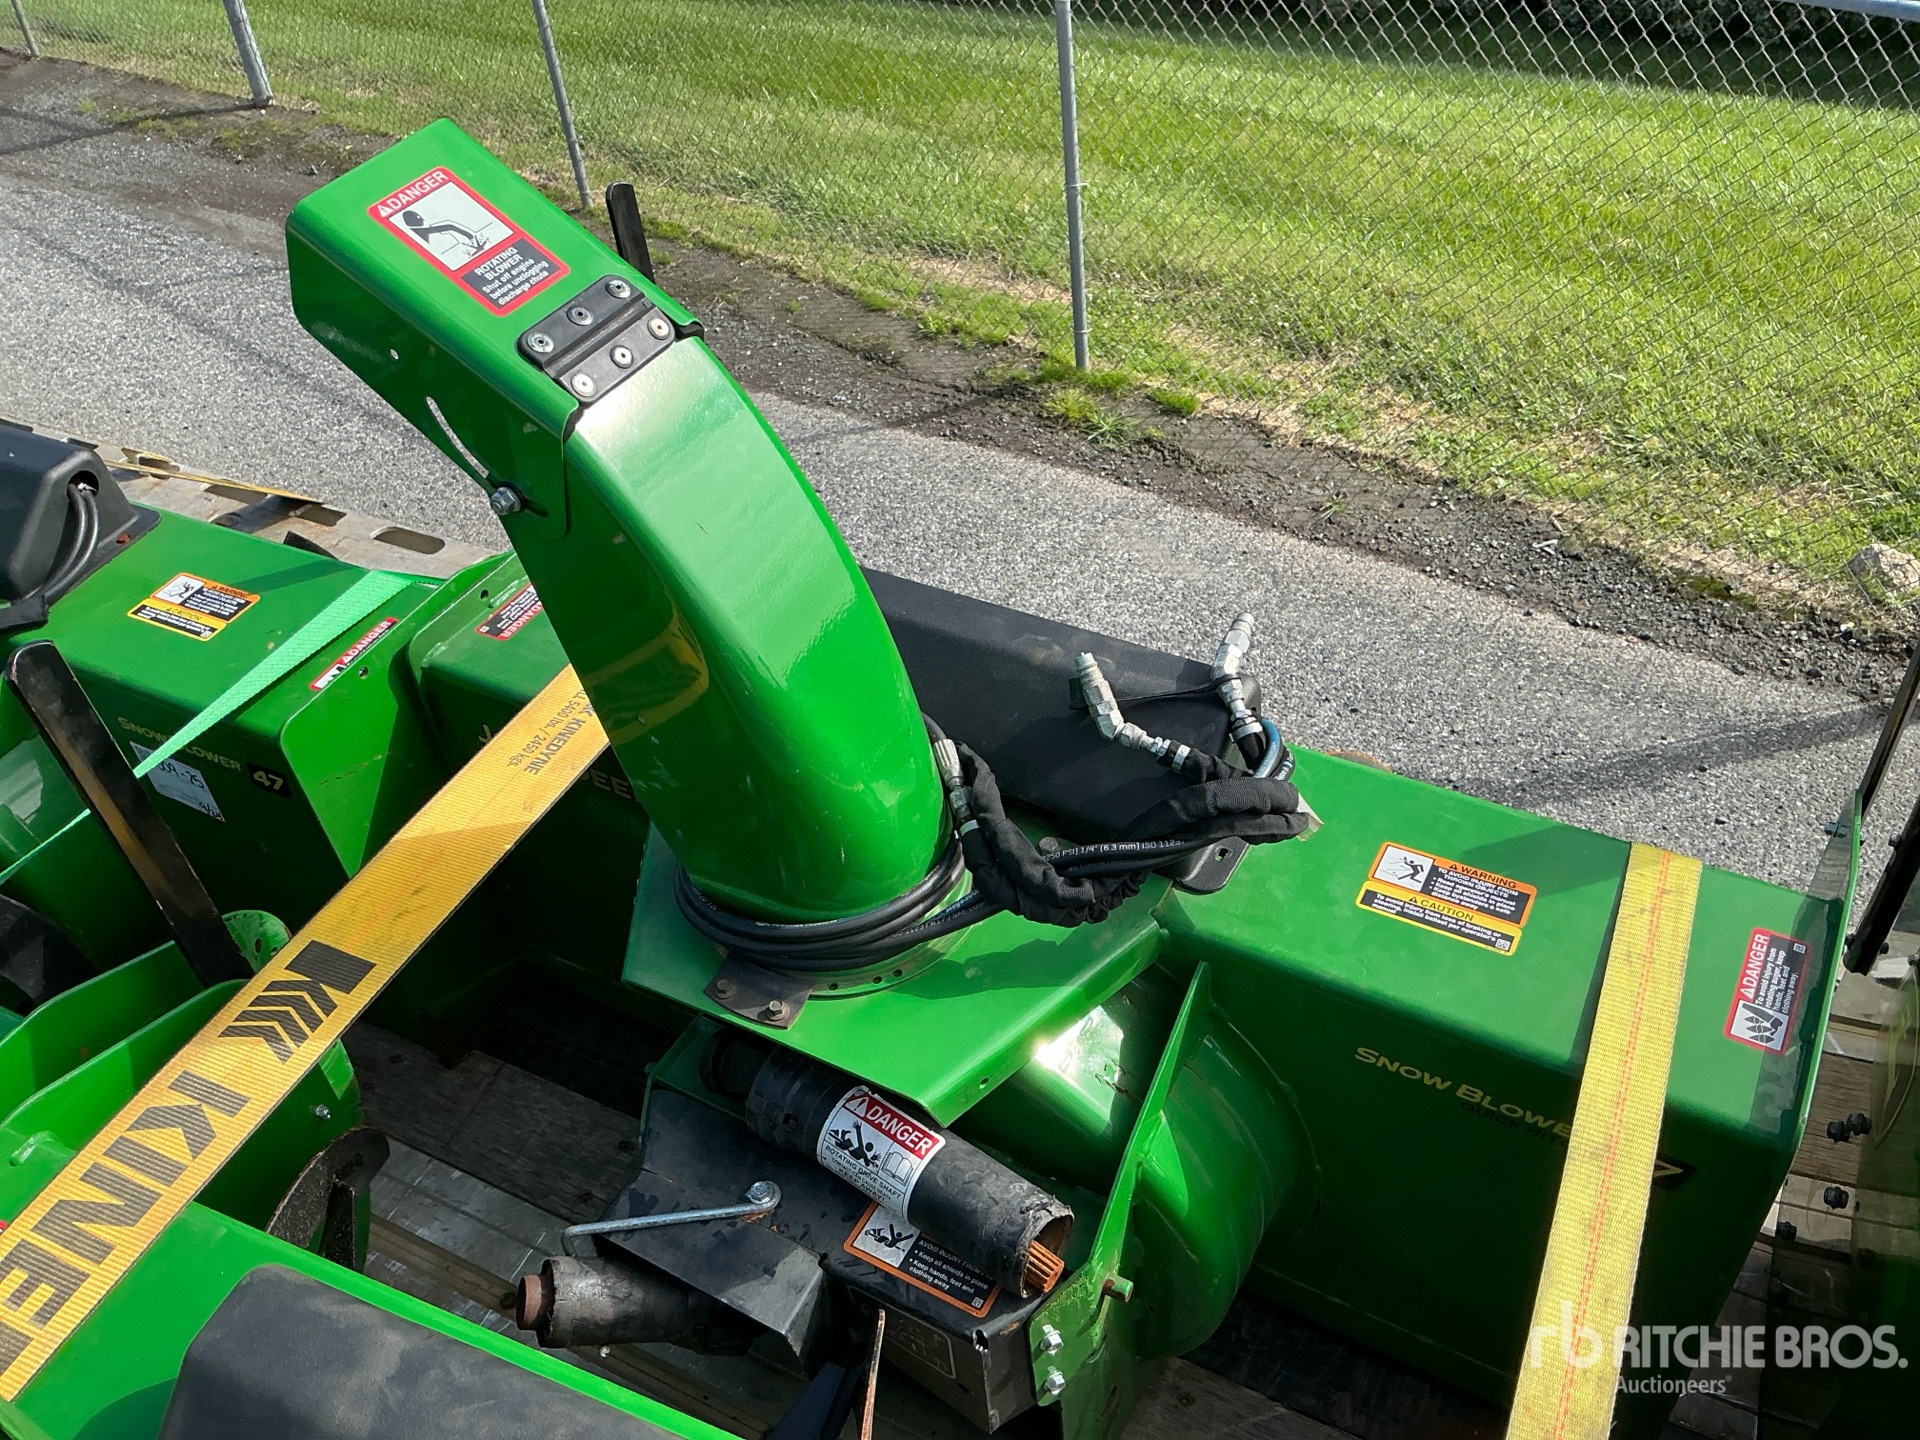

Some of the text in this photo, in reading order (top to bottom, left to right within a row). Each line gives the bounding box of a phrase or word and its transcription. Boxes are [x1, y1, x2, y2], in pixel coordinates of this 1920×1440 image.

[386, 171, 449, 210] DANGER
[474, 247, 518, 275] ROTATING
[484, 254, 523, 280] BLOWER
[482, 259, 535, 293] Shut off engine
[490, 283, 513, 299] before
[511, 260, 549, 285] unclogging
[498, 282, 531, 305] discharge
[530, 270, 549, 284] chute
[170, 607, 202, 621] CAUTION
[501, 604, 542, 637] DANGER
[348, 621, 392, 657] DANGER
[557, 700, 581, 721] 5400
[524, 717, 587, 775] KINEDYNE
[526, 734, 547, 754] 2450
[182, 745, 242, 772] LOWER
[253, 770, 284, 791] 47
[1119, 842, 1140, 851] mm]
[1142, 841, 1157, 849] ISO
[1437, 877, 1516, 906] Read operator's manual
[1444, 873, 1509, 898] THROWN OBJECTS
[1448, 870, 1470, 881] AVOID
[1470, 877, 1496, 889] INJURY
[1497, 886, 1518, 896] FROM
[1461, 866, 1517, 889] WARNING
[1371, 903, 1397, 915] manual
[1420, 899, 1474, 921] CAUTION
[1431, 891, 1479, 910] distance away
[1433, 886, 1451, 896] Keep
[1451, 892, 1488, 909] bystanders
[1495, 906, 1511, 915] safe
[1435, 882, 1452, 891] Keep
[1463, 891, 1487, 902] shields
[1496, 901, 1516, 911] place
[1386, 896, 1403, 906] avoid
[1405, 902, 1423, 913] injury
[1425, 907, 1441, 918] from
[1442, 913, 1456, 923] loss
[1465, 921, 1492, 936] braking
[1425, 914, 1448, 926] ballast
[1448, 922, 1460, 930] per
[1461, 926, 1496, 942] operator's
[1742, 933, 1770, 992] DANGER
[1755, 948, 1778, 1005] To avoid injury from
[1765, 984, 1778, 1008] rotating
[1778, 950, 1787, 967] keep
[1778, 978, 1788, 991] feet
[1782, 990, 1795, 1014] clothing
[1354, 1047, 1573, 1137] SNOW BLOWE
[866, 1105, 933, 1155] DANGER
[826, 1145, 902, 1199] ROTATING DRIVE SHAFT
[0, 1070, 250, 1375] KINE
[918, 1240, 939, 1252] AVOID
[939, 1249, 962, 1264] INJURY
[909, 1266, 950, 1290] clothing away
[913, 1259, 975, 1293] Keep hands, feet and
[919, 1251, 934, 1263] Keep
[942, 1263, 964, 1278] shields
[971, 1277, 989, 1290] place
